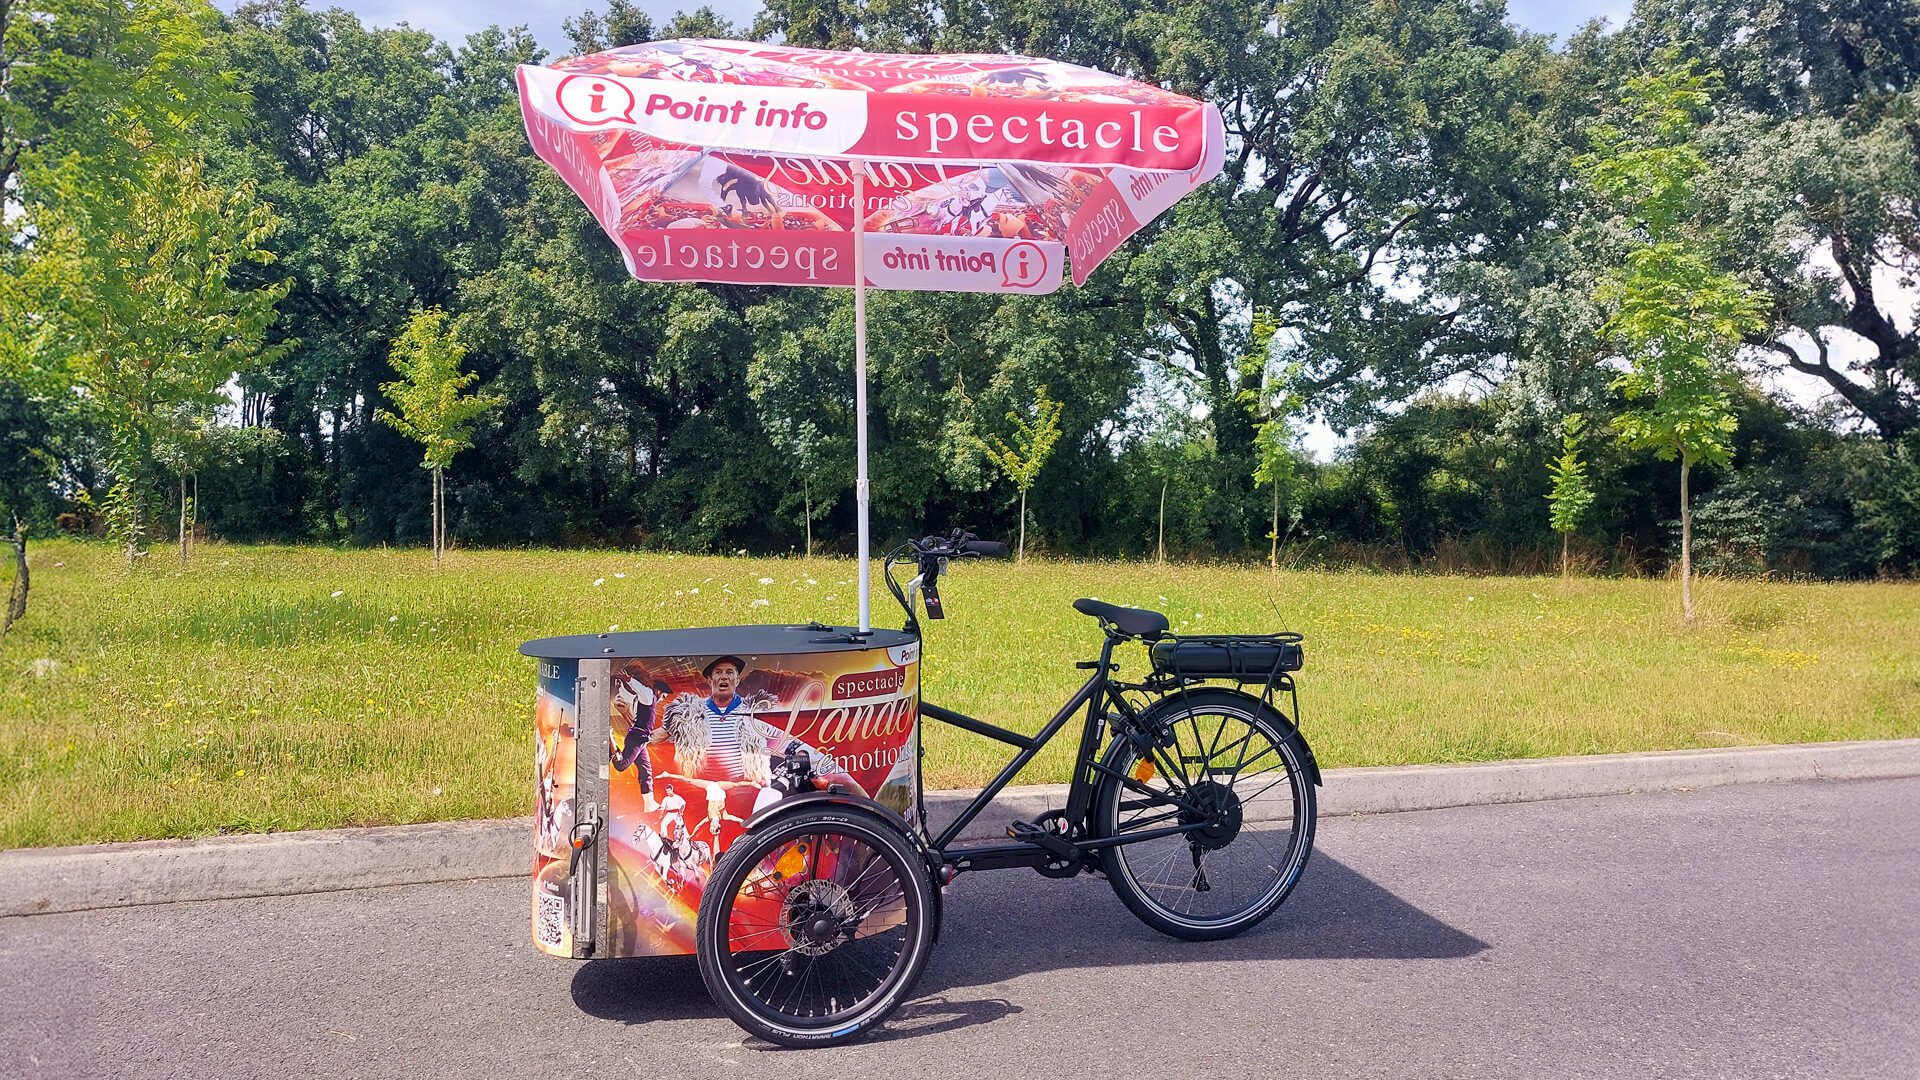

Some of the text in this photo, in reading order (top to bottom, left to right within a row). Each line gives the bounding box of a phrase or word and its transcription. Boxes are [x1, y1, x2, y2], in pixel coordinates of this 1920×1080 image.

[645, 93, 747, 125] Point
[755, 99, 828, 131] info
[895, 109, 1181, 154] spectacle
[837, 672, 904, 698] spectacle
[816, 740, 913, 777] émotions
